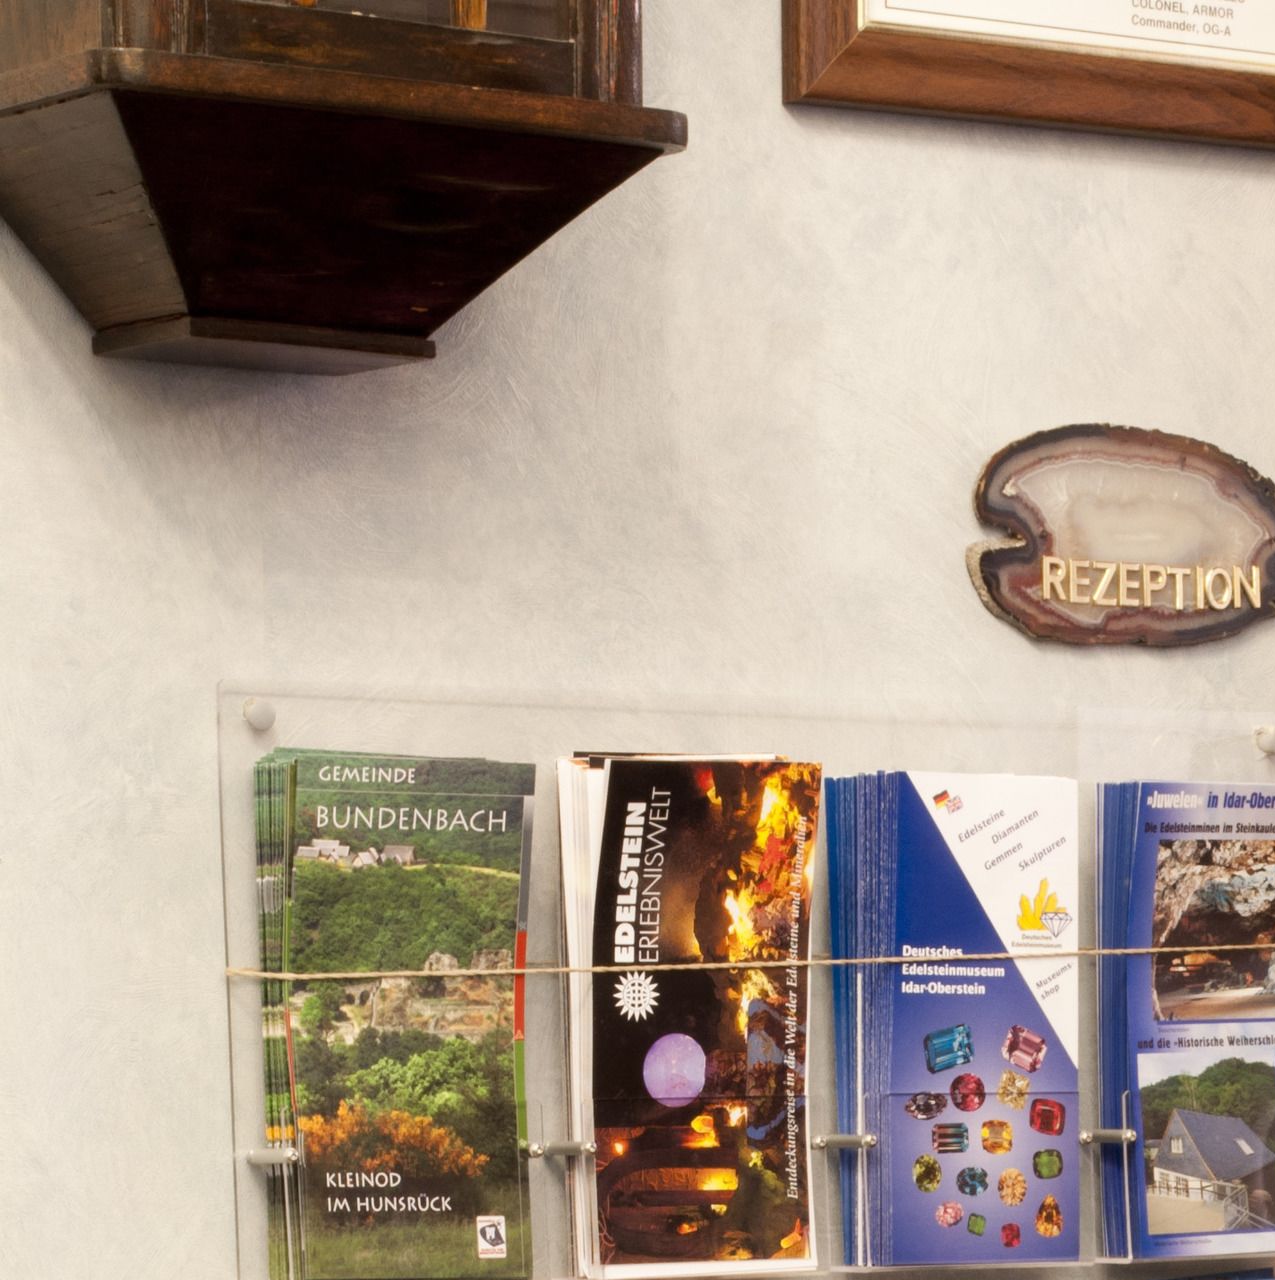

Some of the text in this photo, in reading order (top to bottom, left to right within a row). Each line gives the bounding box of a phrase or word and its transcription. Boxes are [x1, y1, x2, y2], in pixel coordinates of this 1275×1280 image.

[1193, 5, 1234, 19] ARMOR
[1131, 14, 1231, 36] Commander, OG-A
[1042, 555, 1262, 611] REZEPTION
[319, 765, 416, 784] GEMEINDE
[1207, 792, 1219, 808] in
[317, 805, 507, 832] BUNDENBACH
[958, 809, 1005, 842] Edelsteine
[991, 810, 1039, 844] Diamanten
[1145, 823, 1157, 833] Die
[1160, 823, 1220, 833] Edelsteinminen
[1223, 823, 1233, 833] im
[984, 842, 1023, 870] Gemmen
[1018, 836, 1067, 871] Skulpturen
[614, 802, 647, 963] EDELSTEIN
[638, 786, 672, 963] ERLEBNISWELT
[902, 945, 963, 958] Deutsches
[902, 964, 1005, 977] Edelsteinmuseum
[901, 981, 985, 995] Idar-Oberstein
[1041, 984, 1061, 1000] shop
[1138, 1038, 1154, 1048] und
[1157, 1037, 1171, 1048] die
[784, 1049, 796, 1068] die
[783, 1071, 796, 1087] in
[783, 1089, 799, 1200] Entdeckungsreise
[326, 1172, 401, 1188] KLEINOD
[328, 1193, 452, 1212] IM HUNSRÜCK
